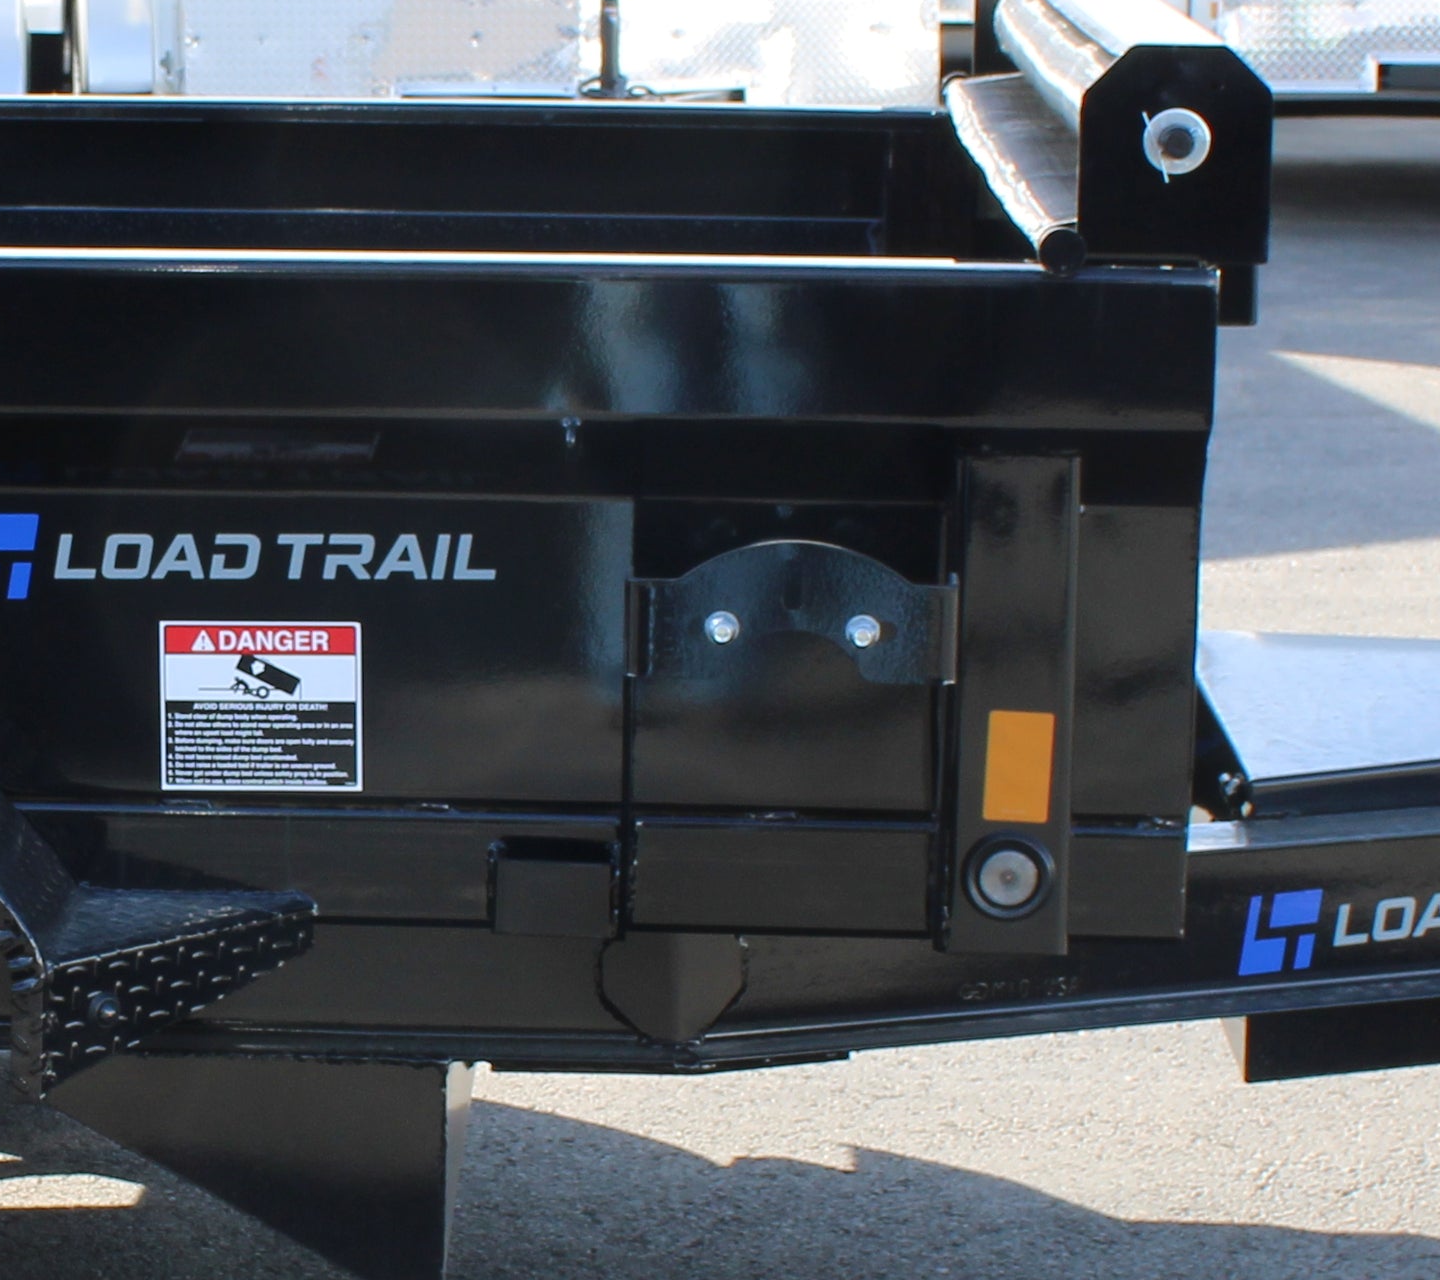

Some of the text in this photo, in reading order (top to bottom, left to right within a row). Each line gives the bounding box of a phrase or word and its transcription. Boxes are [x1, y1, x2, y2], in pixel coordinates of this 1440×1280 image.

[54, 533, 261, 579] LOAD
[277, 534, 497, 581] TRAIL
[219, 630, 330, 652] DANGER
